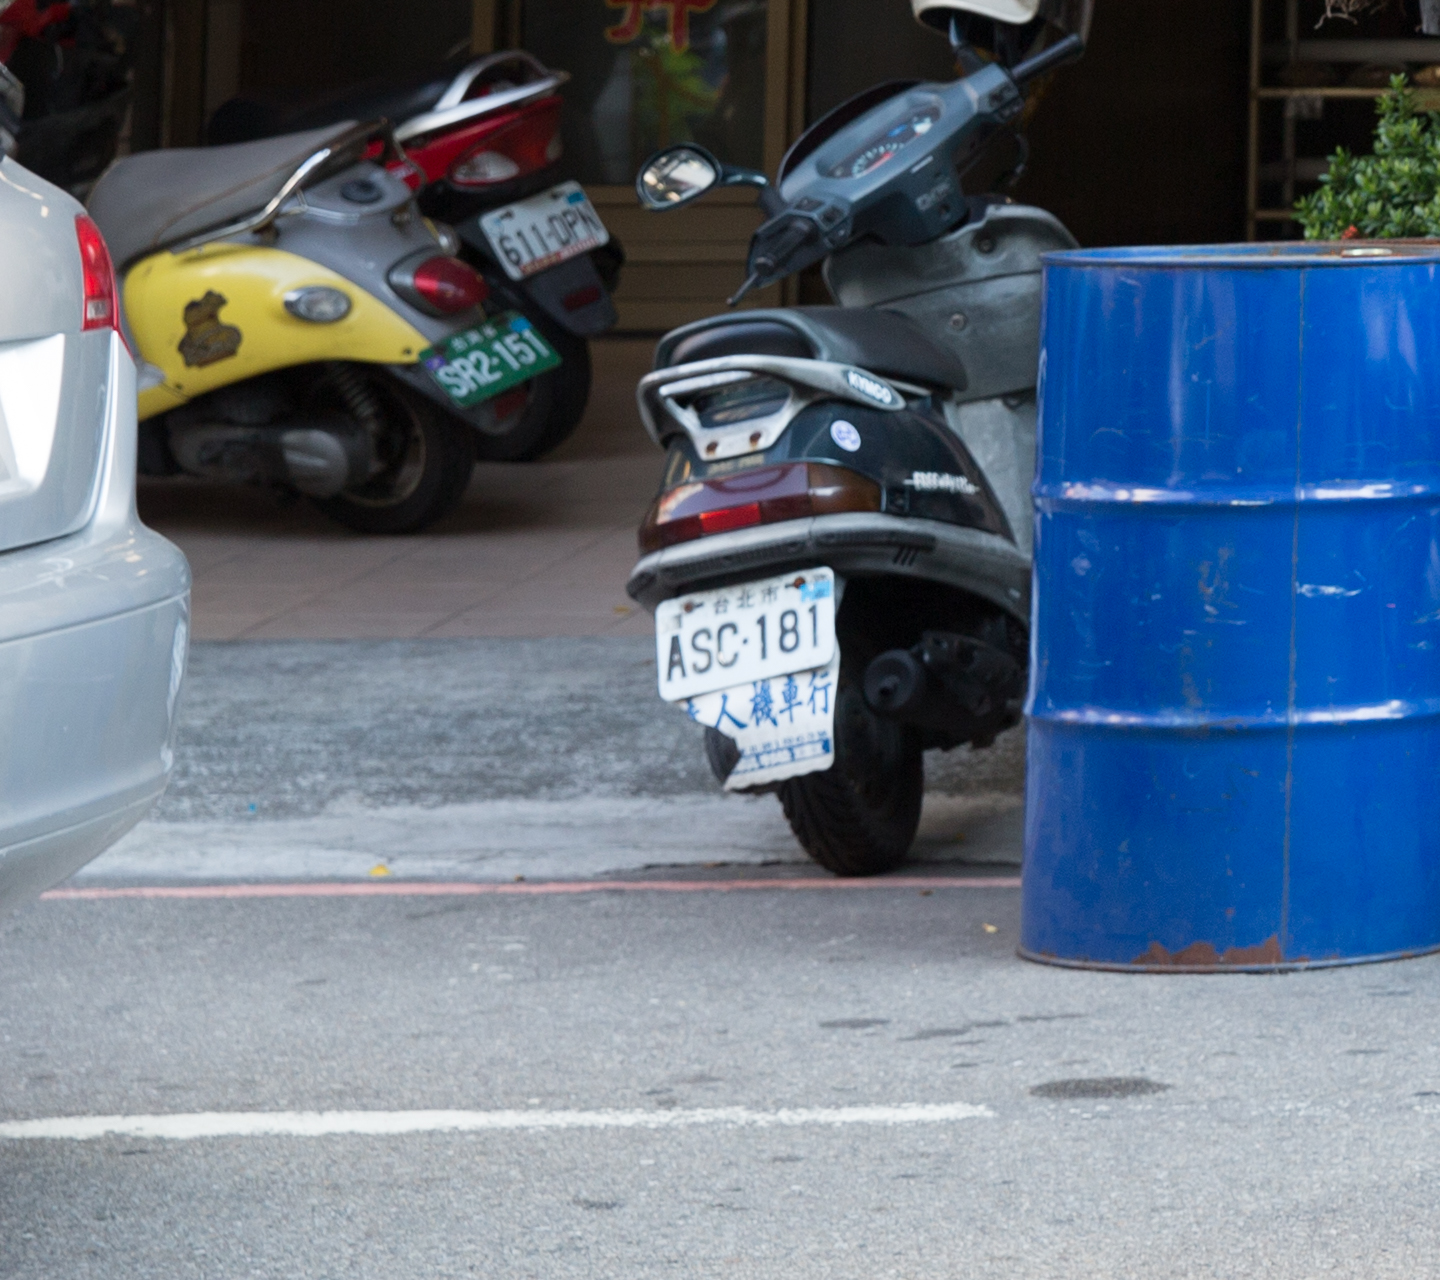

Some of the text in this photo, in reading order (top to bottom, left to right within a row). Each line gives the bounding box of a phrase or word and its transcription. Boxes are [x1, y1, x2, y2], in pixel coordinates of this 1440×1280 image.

[848, 370, 893, 404] KYMCO
[714, 586, 779, 615] 台北市
